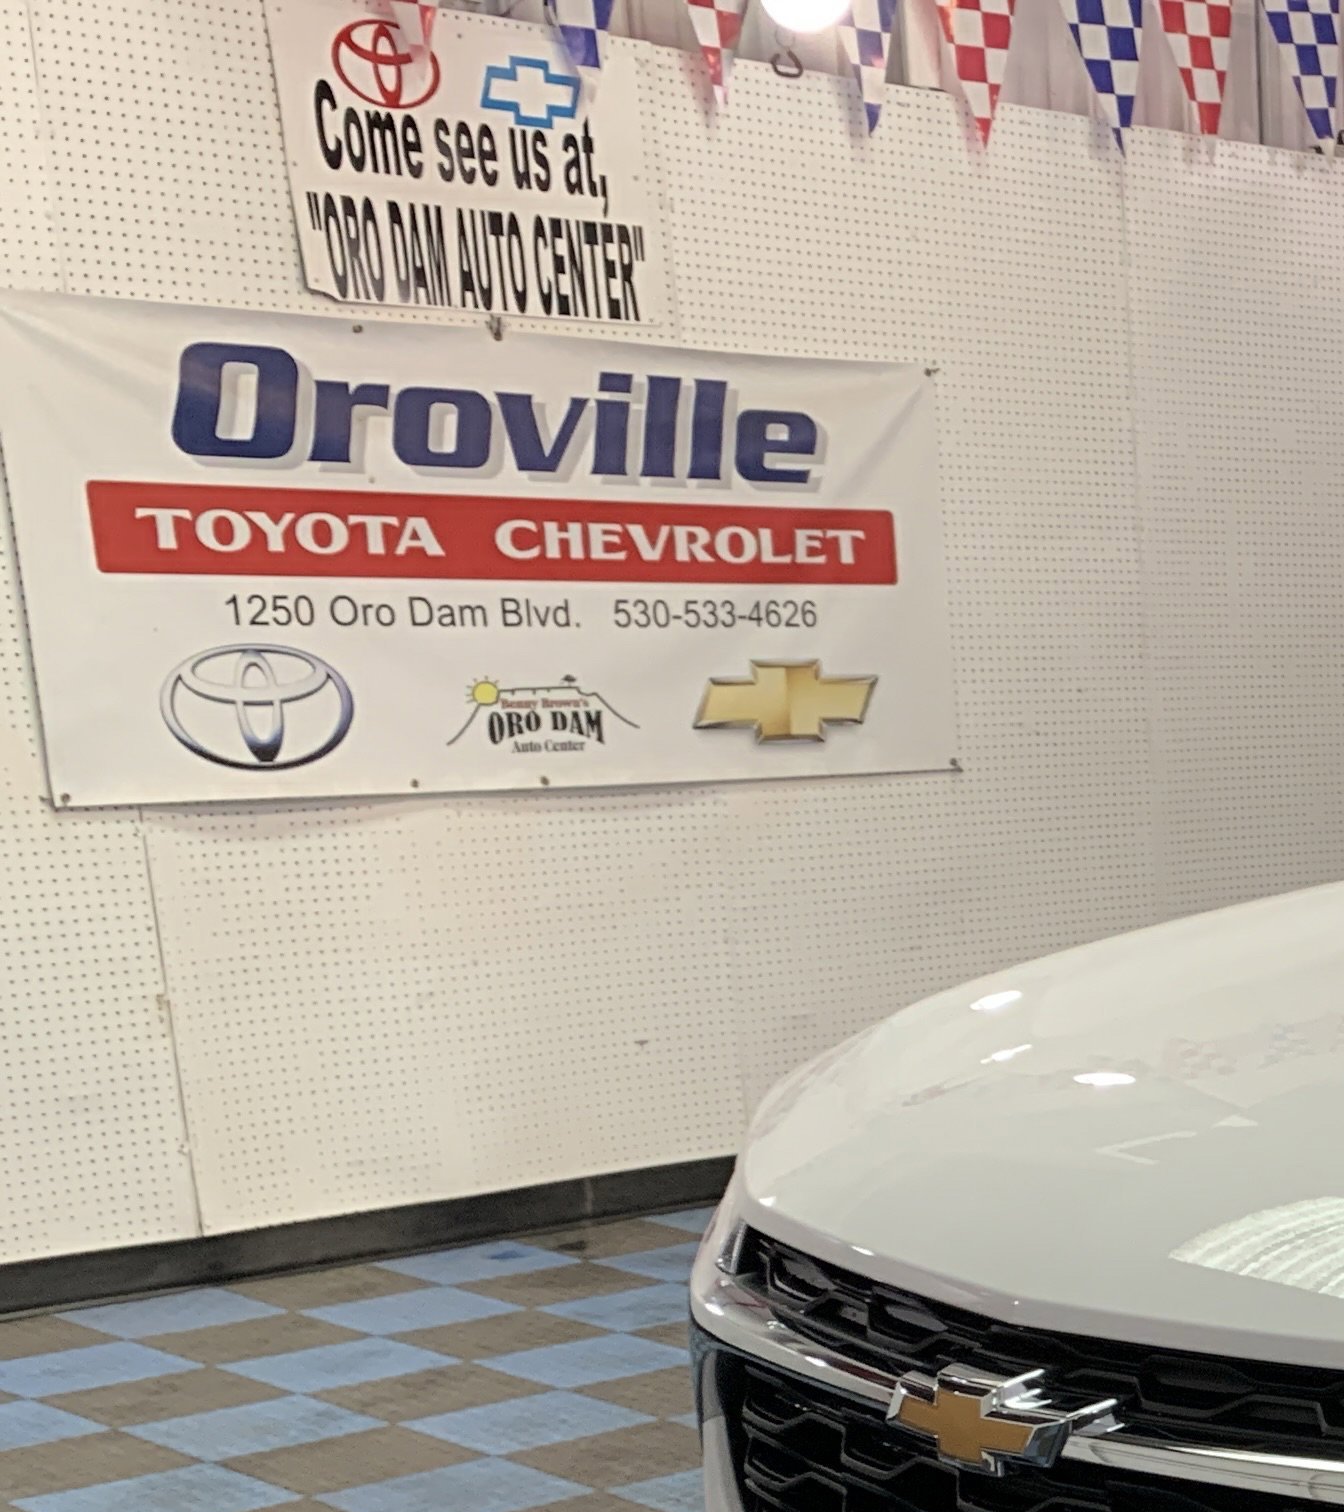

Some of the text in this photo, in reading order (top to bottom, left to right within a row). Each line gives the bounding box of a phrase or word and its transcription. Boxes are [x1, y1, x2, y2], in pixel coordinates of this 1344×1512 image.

[314, 79, 608, 217] Come see us at,
[306, 192, 645, 320] "ORO DAM AUTO CENTER"
[171, 341, 820, 485] Oroville
[135, 506, 866, 566] TOYOTA CHEVROLET
[224, 594, 818, 629] 1250 Oro Dam Blvd. 530-533-4626
[488, 709, 605, 745] ORO DAM
[511, 739, 586, 753] Auto Center
